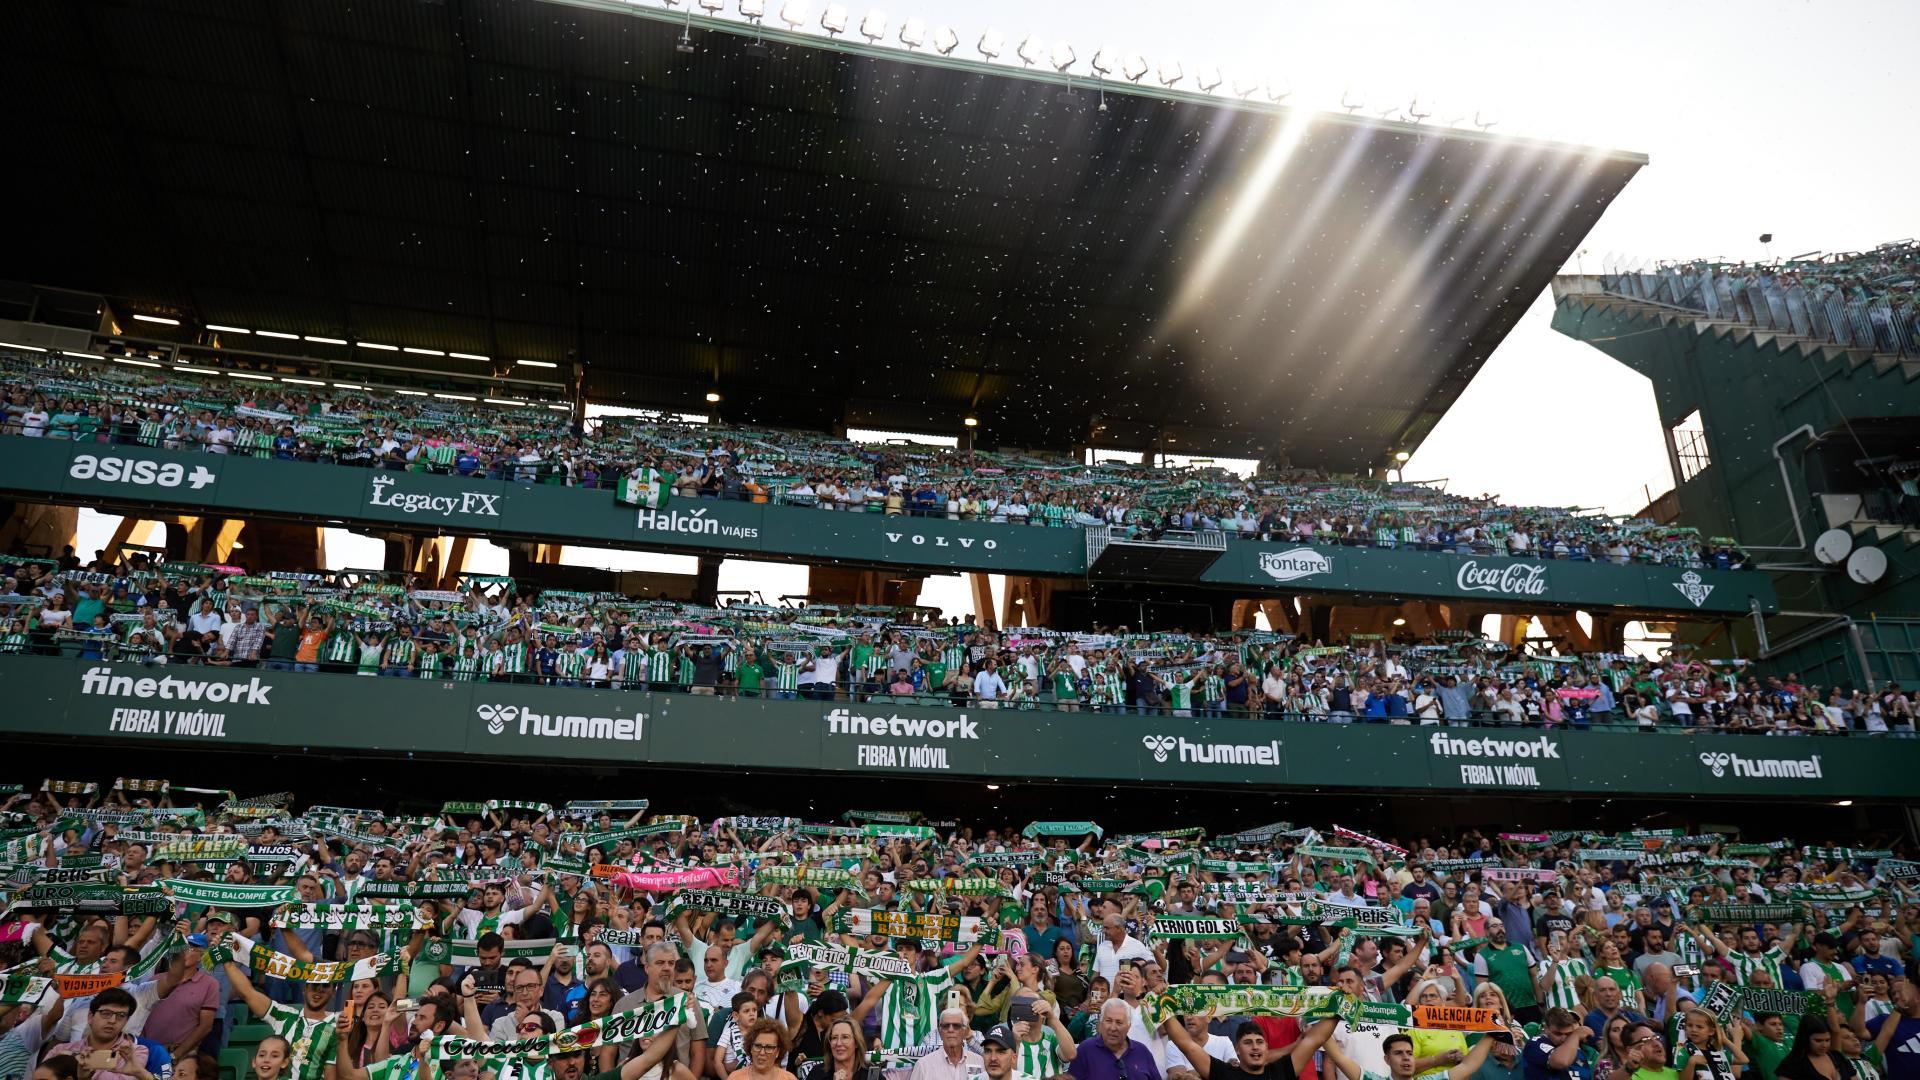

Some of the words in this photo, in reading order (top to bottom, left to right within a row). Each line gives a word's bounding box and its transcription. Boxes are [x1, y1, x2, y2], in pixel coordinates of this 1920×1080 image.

[70, 455, 184, 487] asisa
[637, 507, 718, 535] Halcón
[722, 526, 758, 538] VIAJES
[886, 533, 997, 549] VOLVO
[1259, 552, 1332, 573] Fontarel
[82, 666, 272, 705] finetwork
[110, 708, 161, 734] FIBRA
[163, 710, 176, 733] Y
[175, 709, 226, 737] MÓVIL
[519, 706, 643, 741] hummel
[827, 709, 979, 740] finetwork
[1179, 736, 1280, 766] hummel
[1430, 732, 1560, 759] finetwork
[858, 745, 897, 767] FIBRA
[898, 747, 908, 767] Y
[909, 743, 949, 769] MÓVIL
[1461, 764, 1495, 784] FIBRA
[1494, 766, 1503, 785] Y
[1503, 763, 1541, 786] MÓVIL
[1731, 752, 1822, 779] hummel
[144, 832, 173, 842] Betis
[257, 845, 292, 855] HIJOS
[975, 855, 1006, 864] REAL
[1007, 853, 1040, 863] BETIS
[46, 868, 92, 884] Betis
[953, 877, 997, 890] BETIS
[24, 885, 74, 902] EURO
[172, 884, 194, 895] REAL
[195, 888, 220, 899] BETIS
[221, 890, 268, 900] BALOMPIÉ
[687, 888, 713, 896] DICEN
[734, 892, 774, 902] ESTAMOS
[122, 899, 170, 915] BETIS
[682, 892, 725, 908] REAL
[728, 897, 780, 914] BETIS
[872, 911, 911, 925] REAL
[915, 913, 960, 928] BETIS
[1197, 920, 1221, 935] GOL
[877, 923, 953, 939] BALOMPIE
[251, 944, 297, 966] REAL
[853, 954, 867, 968] de
[869, 957, 912, 974] LONDRES
[254, 958, 347, 982] BALOMPIE
[64, 977, 113, 992] VALENCIA
[1364, 1004, 1398, 1015] Balompié
[1426, 1008, 1472, 1023] VALENCIA
[1474, 1009, 1488, 1023] CF
